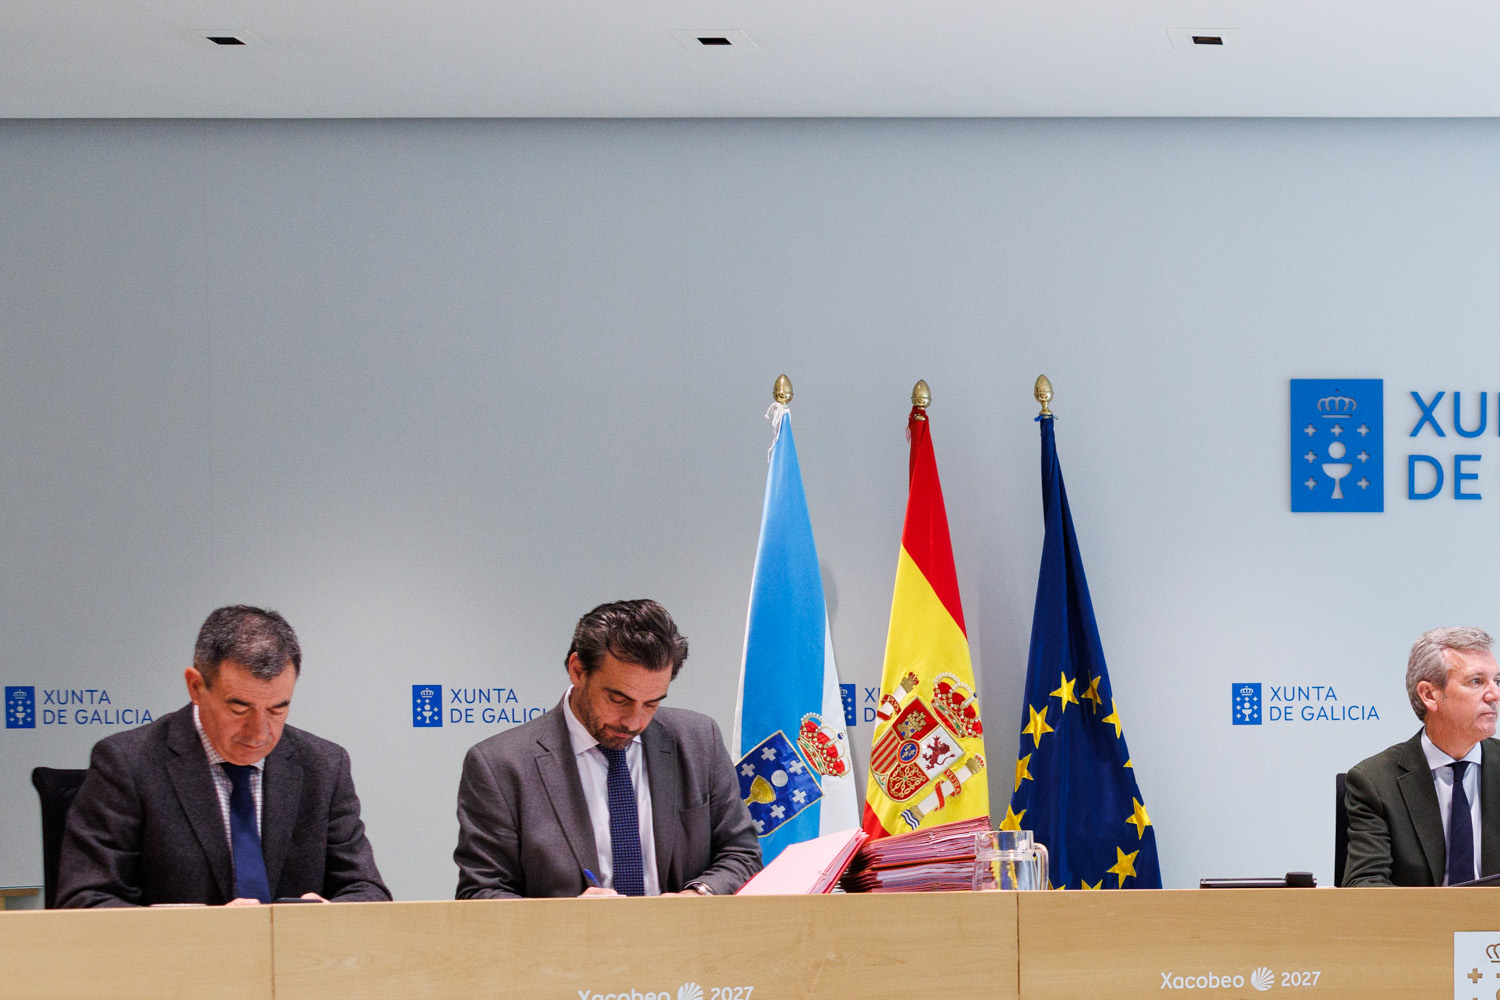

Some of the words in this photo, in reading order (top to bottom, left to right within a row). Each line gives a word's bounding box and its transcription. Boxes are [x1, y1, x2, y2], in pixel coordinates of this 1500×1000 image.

[1408, 454, 1483, 500] DE
[43, 689, 112, 705] XUNTA
[450, 688, 519, 704] XUNTA
[1269, 686, 1338, 702] XUNTA
[43, 709, 68, 725] DE
[74, 709, 154, 725] GALICIA
[450, 708, 475, 724] DE
[1269, 706, 1294, 721] DE
[1301, 705, 1380, 721] GALICIA
[1160, 971, 1245, 990] Xacobeo
[1280, 971, 1321, 987] 2027
